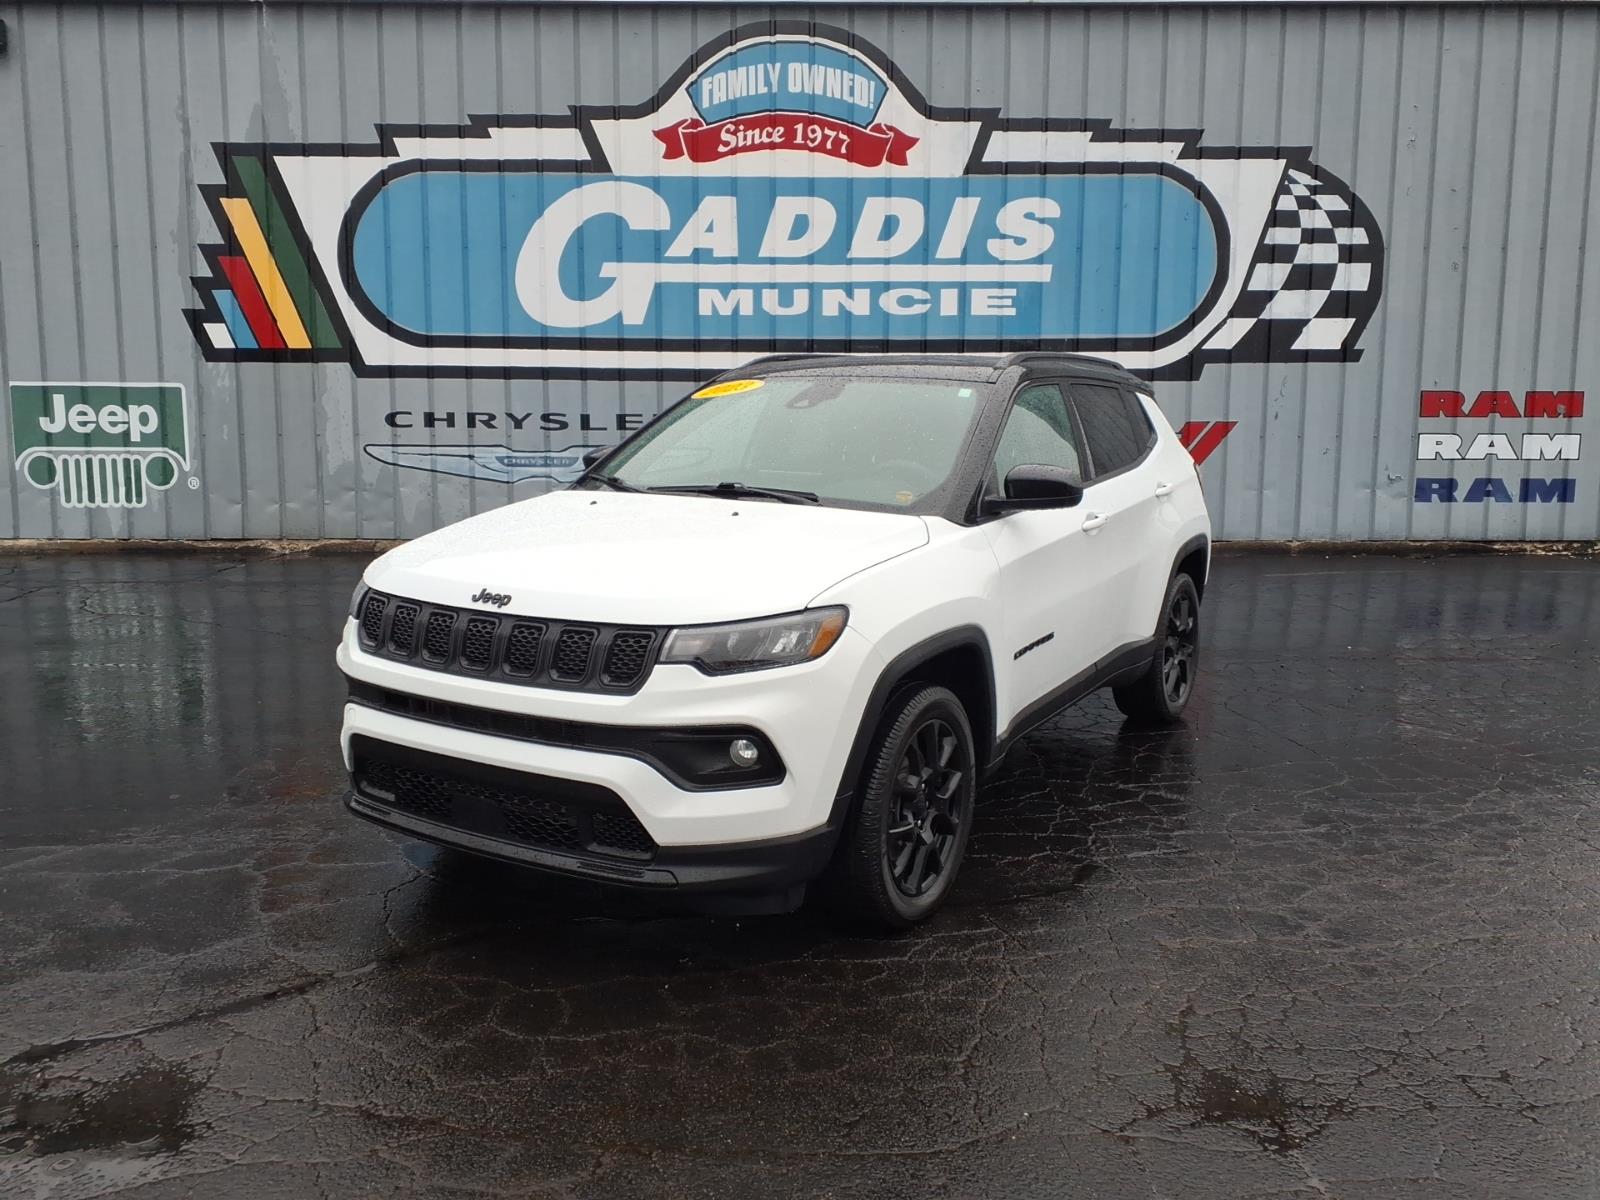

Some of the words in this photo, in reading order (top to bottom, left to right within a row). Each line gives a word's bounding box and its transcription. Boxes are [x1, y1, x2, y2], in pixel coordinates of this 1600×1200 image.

[702, 62, 782, 109] FAMILY
[787, 62, 876, 109] OWNED!
[717, 123, 786, 153] Since
[793, 122, 850, 154] 1977
[514, 180, 1062, 329] GADDIS
[697, 287, 1018, 317] MUNCIE
[39, 393, 159, 442] Jeep
[1419, 390, 1585, 418] RAM
[384, 411, 658, 432] CHRYSLE
[1416, 433, 1582, 461] RAM
[1414, 477, 1577, 503] RAM
[471, 588, 512, 609] Jeep
